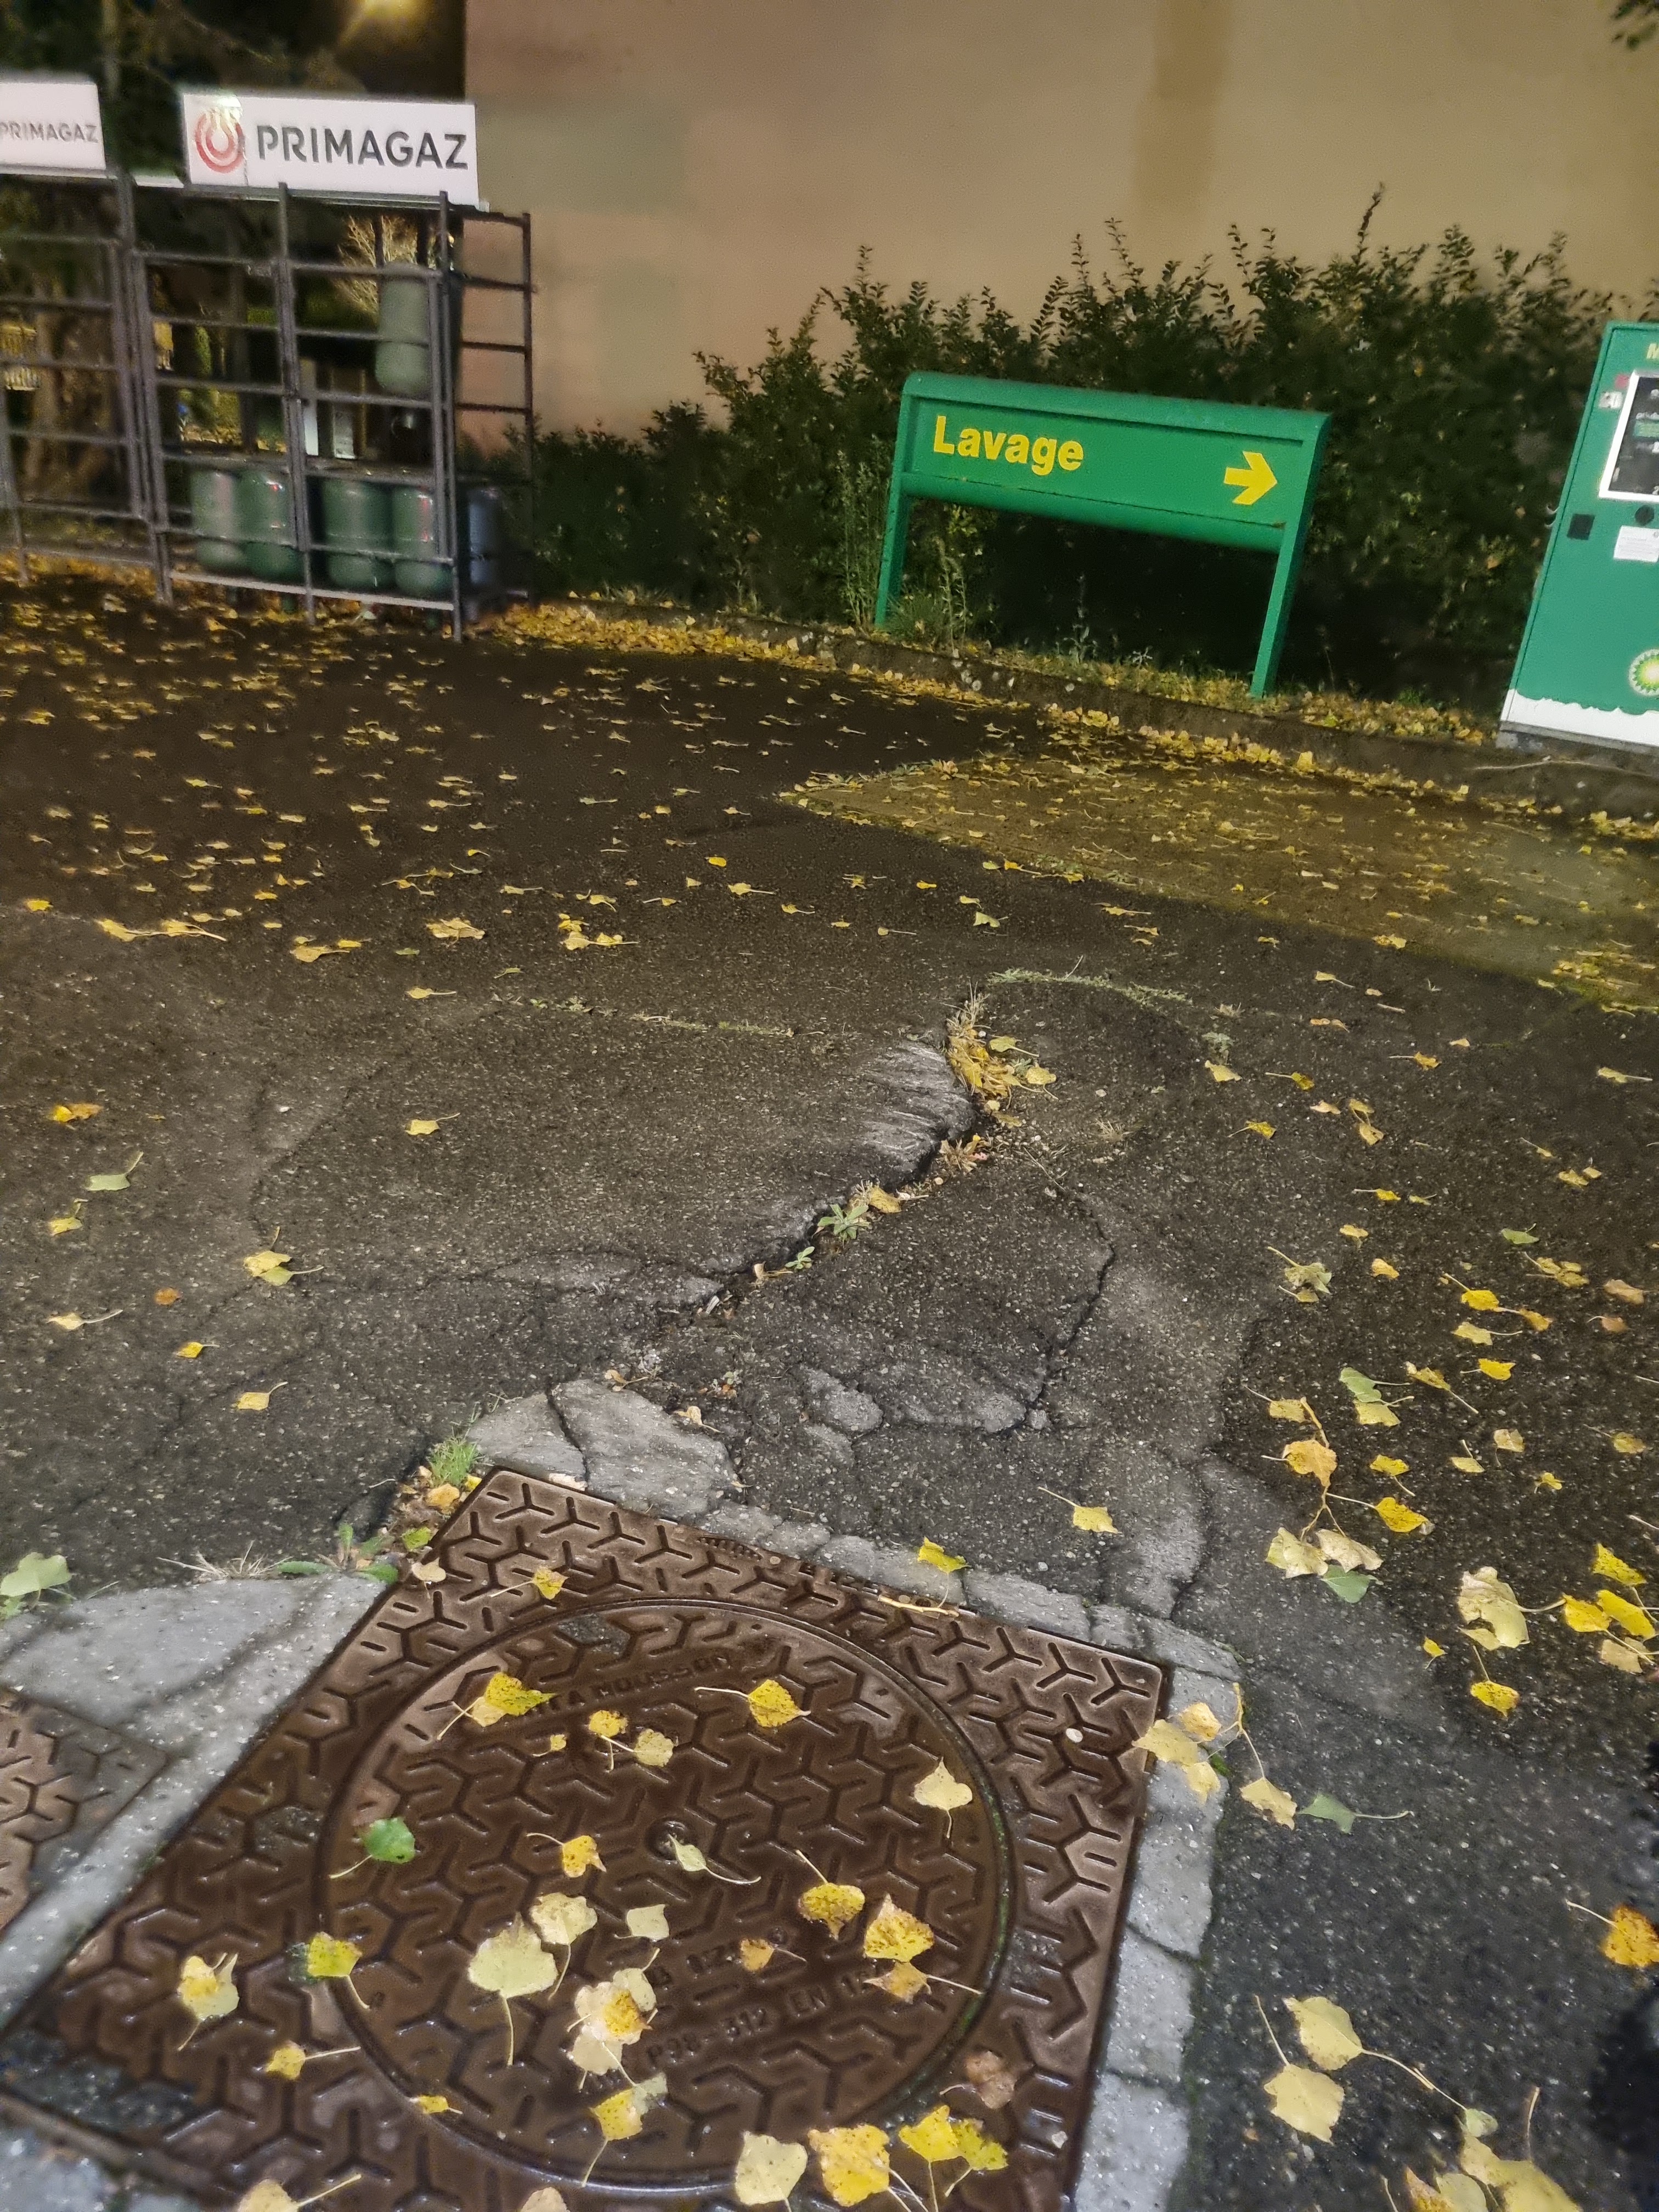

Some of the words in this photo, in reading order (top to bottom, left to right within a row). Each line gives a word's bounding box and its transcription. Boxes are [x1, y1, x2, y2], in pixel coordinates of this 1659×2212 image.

[257, 126, 468, 170] PRIMAGAZ
[933, 415, 1085, 476] Lavage
[591, 1654, 731, 1699] MOUSSON
